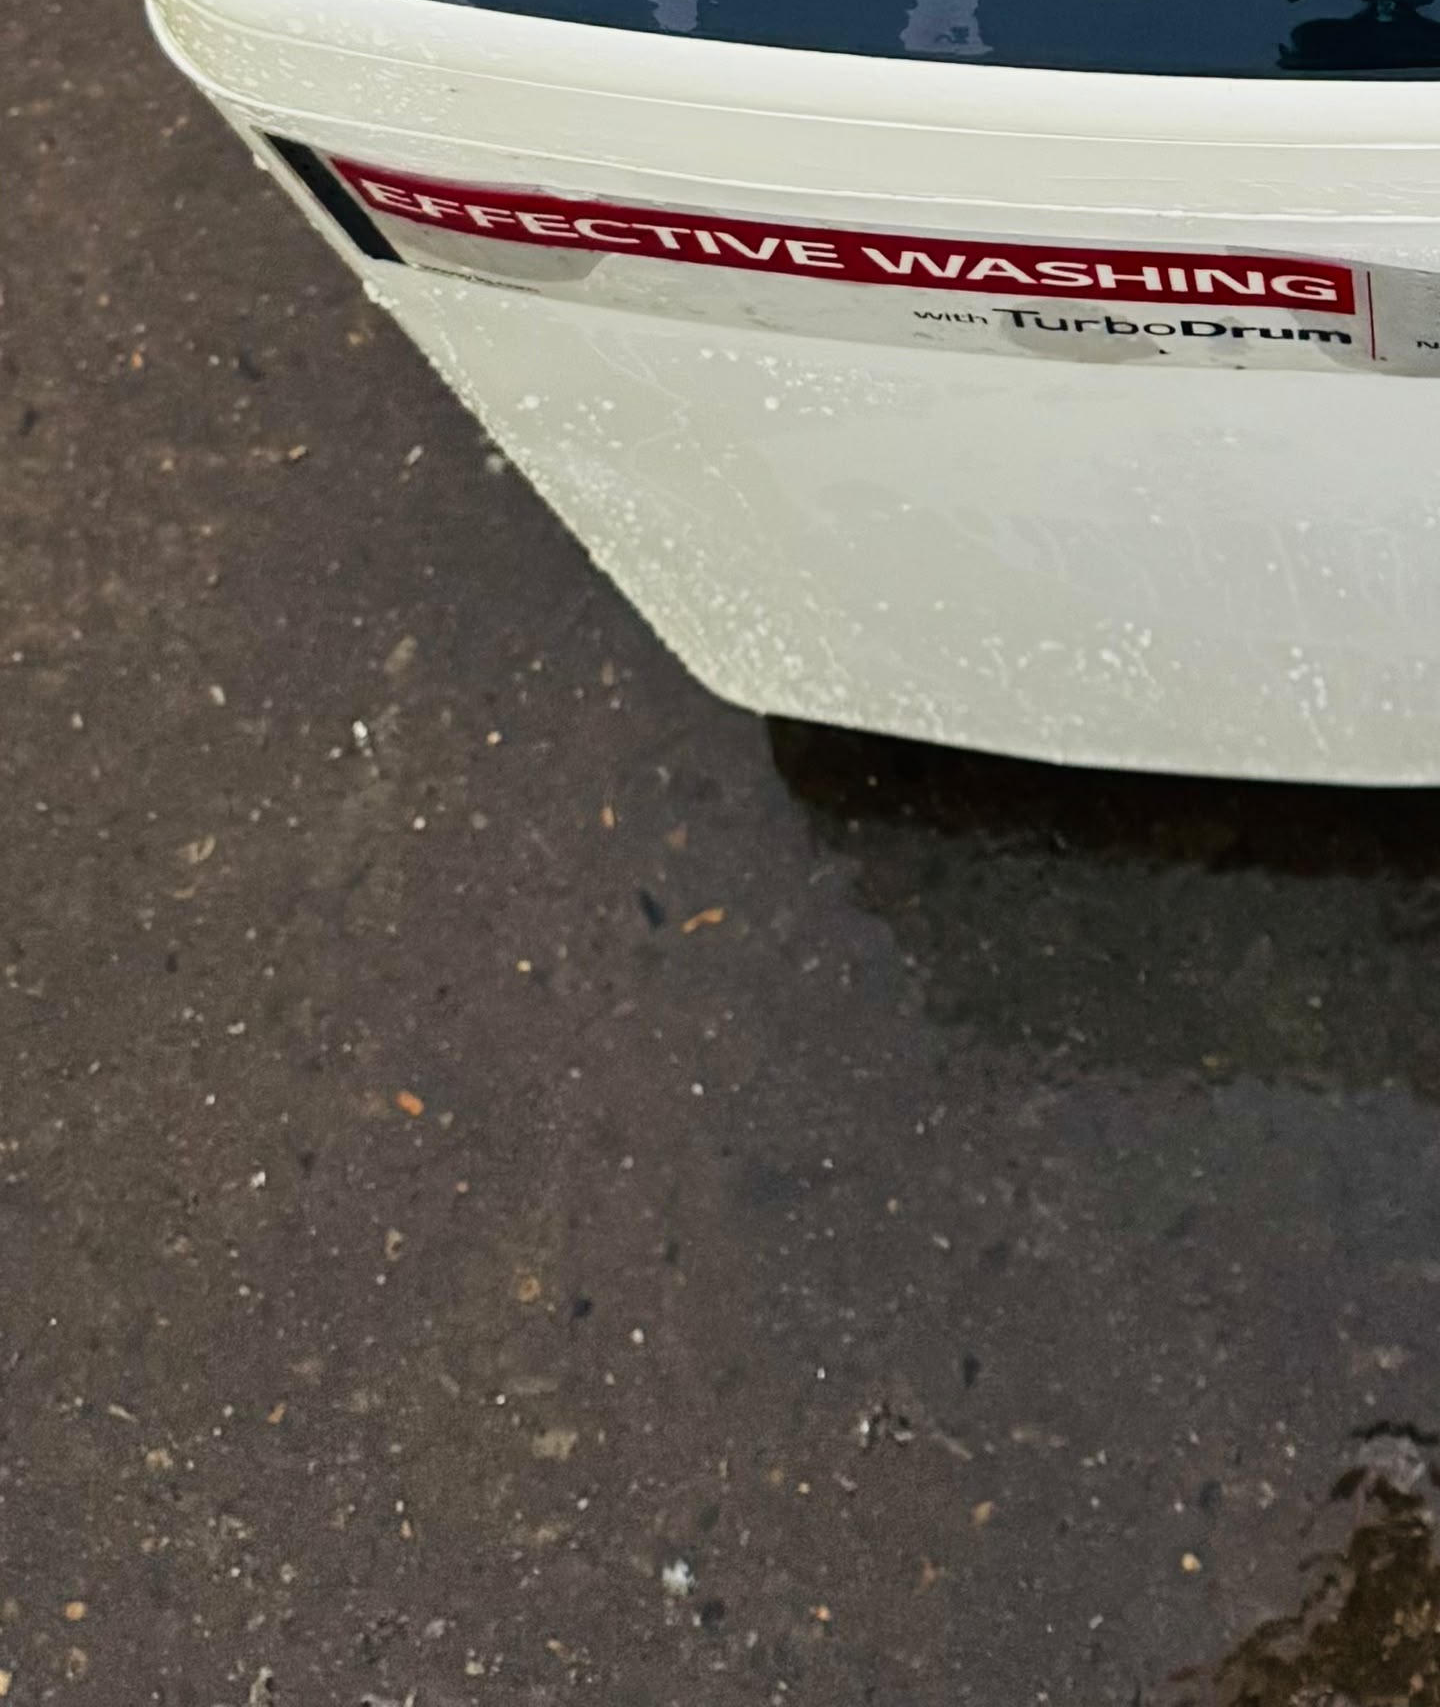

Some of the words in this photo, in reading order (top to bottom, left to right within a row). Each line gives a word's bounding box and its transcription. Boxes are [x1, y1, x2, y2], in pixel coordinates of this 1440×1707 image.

[359, 178, 845, 269] EFFECTIVE
[861, 247, 1339, 302] WASHING
[913, 309, 988, 326] with
[993, 307, 1352, 345] TurboDrum
